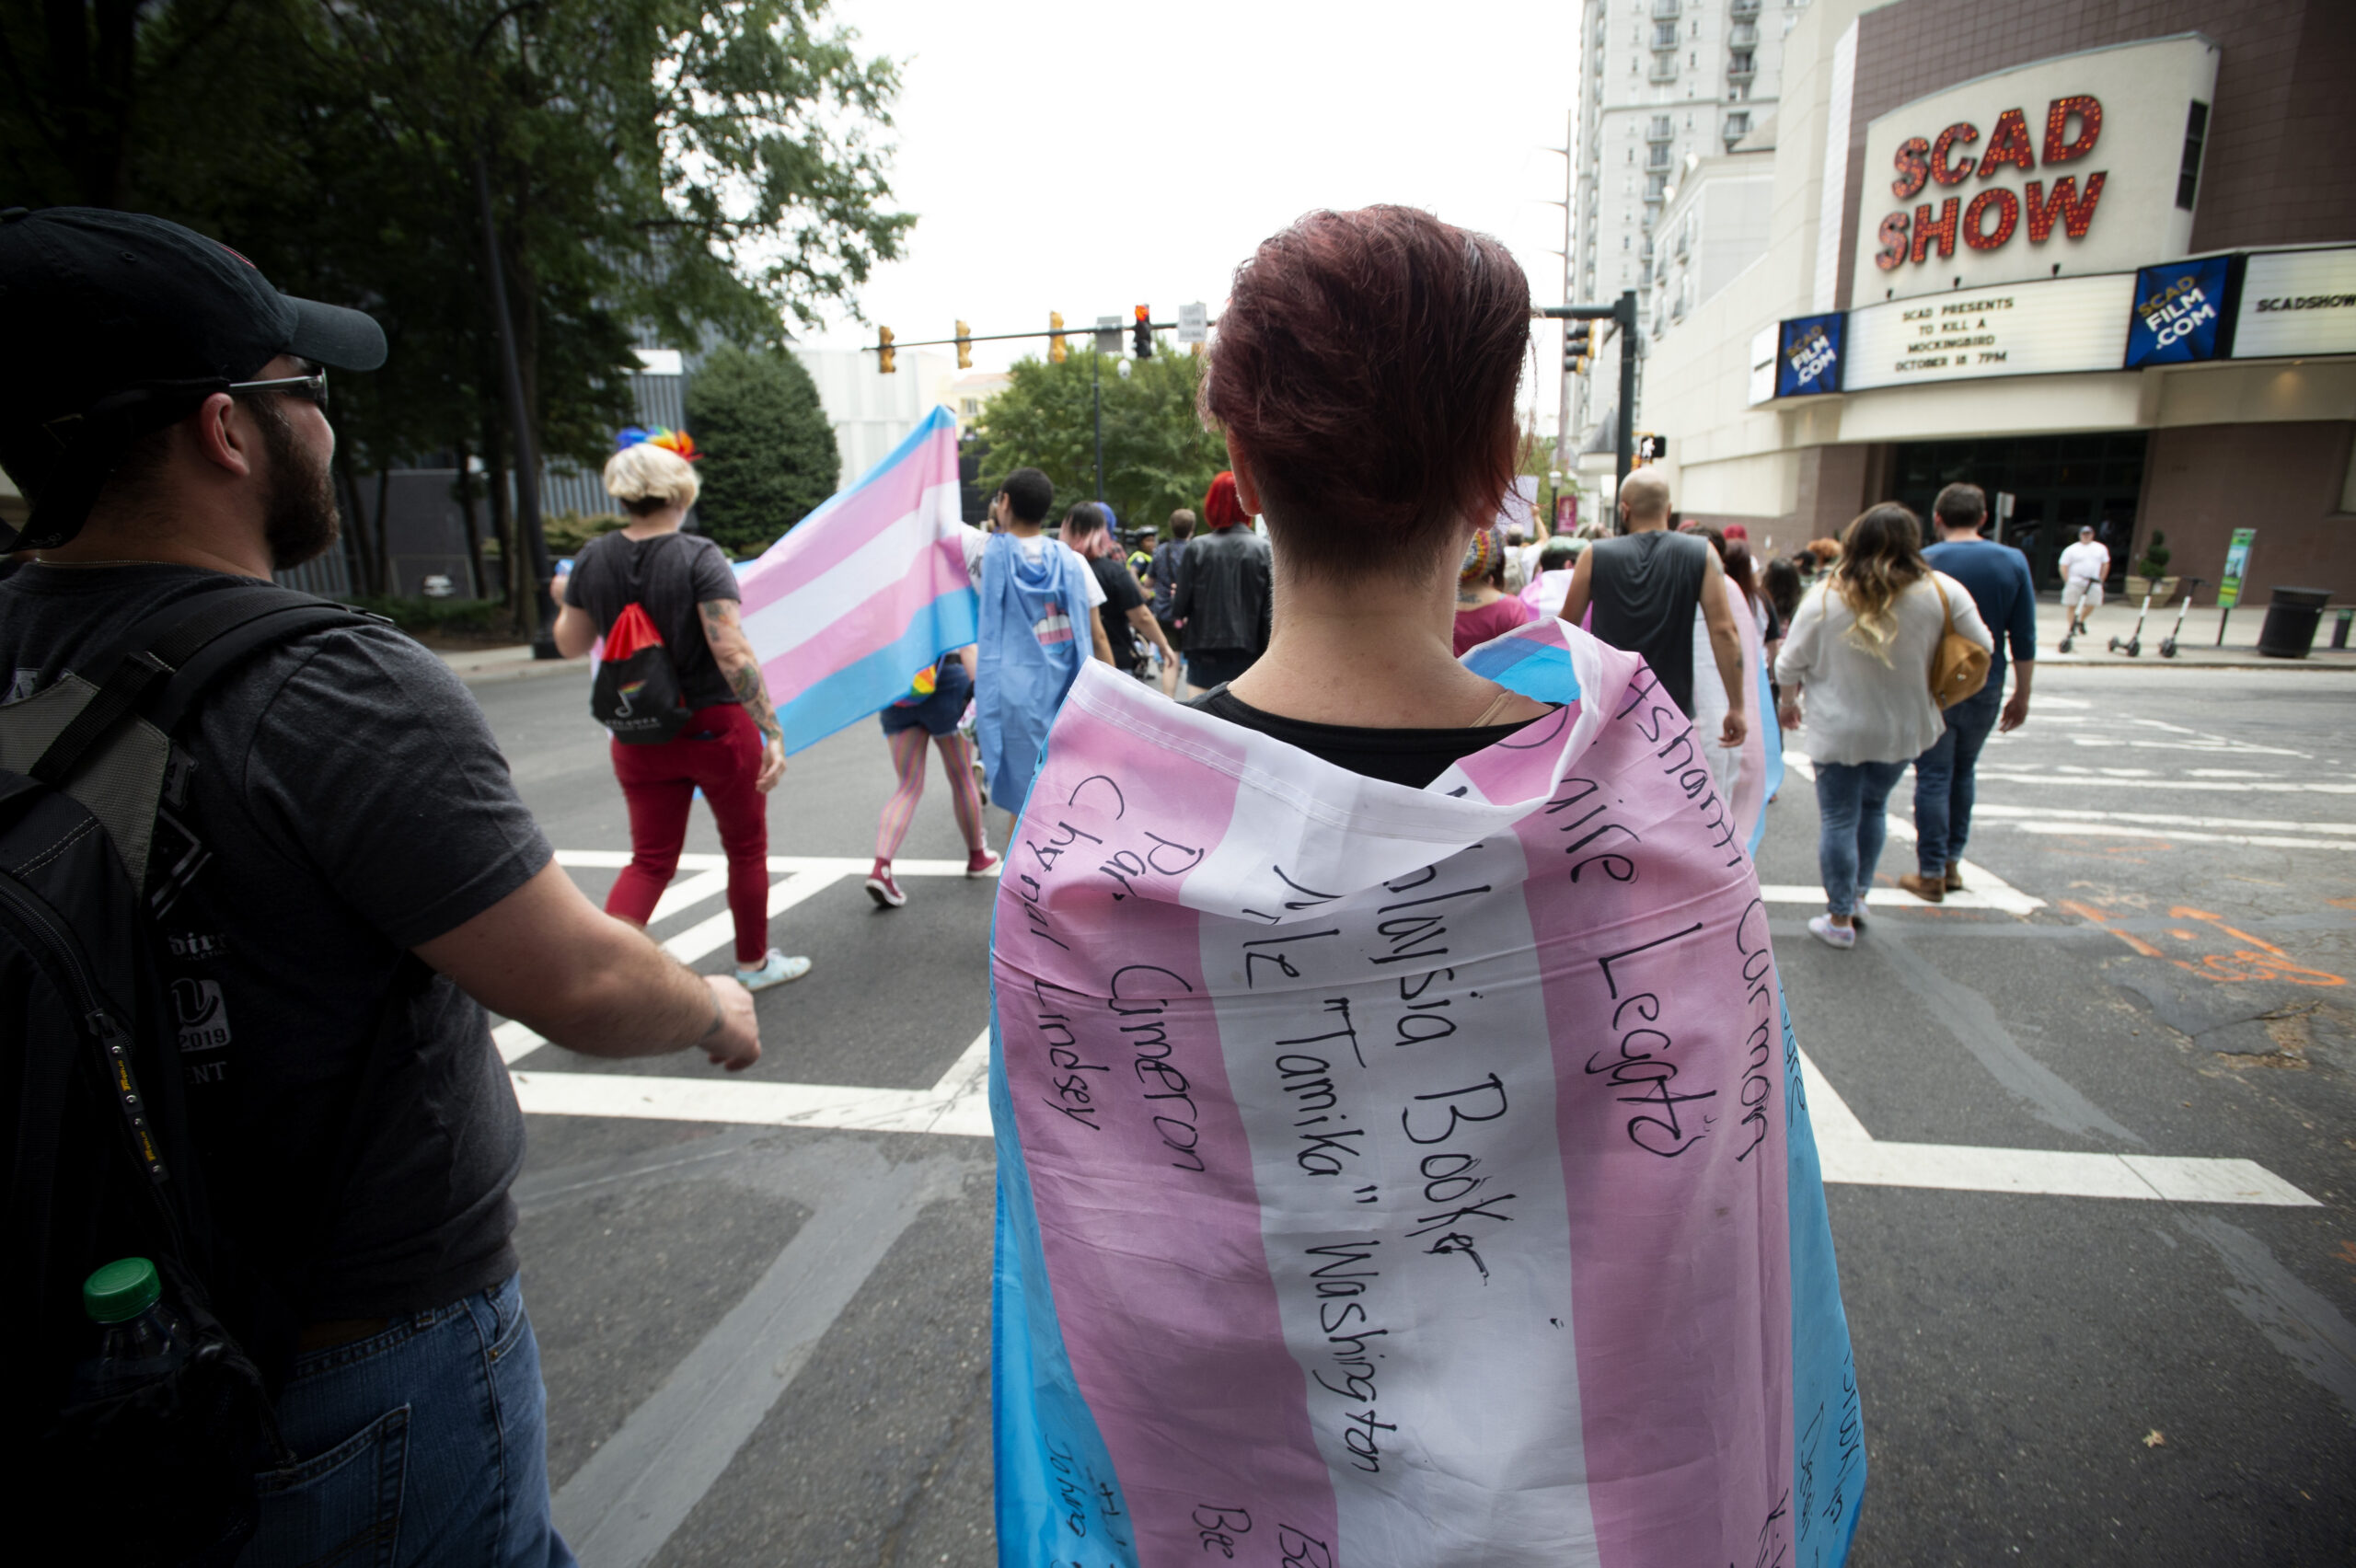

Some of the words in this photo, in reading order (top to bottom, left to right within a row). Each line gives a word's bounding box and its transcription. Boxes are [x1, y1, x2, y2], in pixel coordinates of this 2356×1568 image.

[1891, 94, 2104, 201] SCAD
[1876, 170, 2108, 271] SHOW
[1902, 307, 1933, 322] SCAD
[1941, 296, 2014, 316] PRESENTS
[2137, 276, 2196, 317] SCAD
[2145, 287, 2206, 332] FILM
[1908, 335, 1995, 354] MOCKINGBIRD
[1919, 324, 1934, 336] TO
[1977, 317, 1986, 329] A
[2155, 303, 2217, 350] .COM
[1790, 334, 1830, 372] FILM
[1895, 356, 1948, 373] OCTOBER
[178, 1028, 226, 1049] 2019
[1305, 1239, 1397, 1473] Washington
